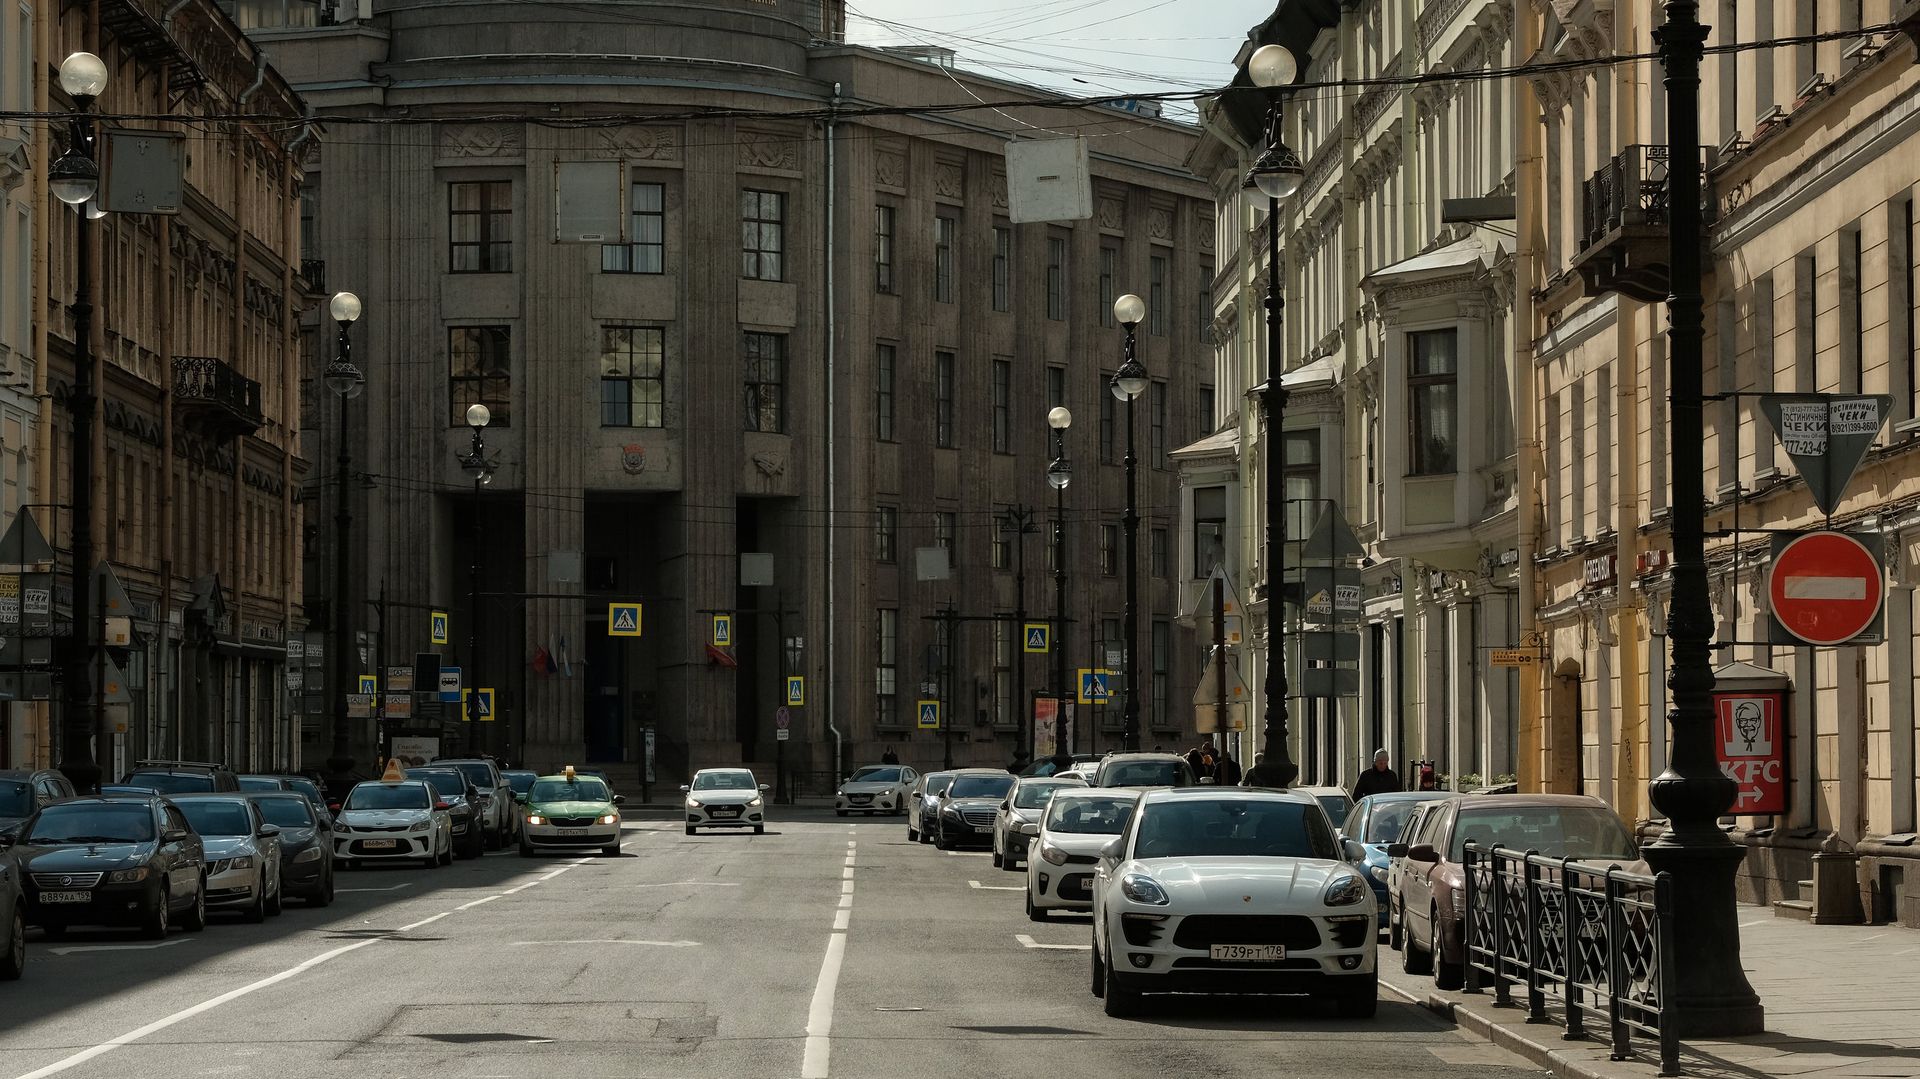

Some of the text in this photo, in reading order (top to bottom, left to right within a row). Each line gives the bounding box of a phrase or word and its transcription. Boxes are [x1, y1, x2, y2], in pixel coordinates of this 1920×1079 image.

[1830, 402, 1876, 414] ГОСТИНИЧНЫЕ
[1783, 412, 1827, 422] ГОСТИНИЧНЫЕ
[1839, 411, 1867, 421] ЧЕКИ
[1783, 422, 1827, 431] ЧЕКИ
[1831, 421, 1878, 433] 8(921)399-8600
[1784, 439, 1827, 454] 777-23-43
[26, 593, 47, 602] ЧЕКИ
[1337, 590, 1358, 598] ЧЕКИ
[1719, 760, 1780, 784] KFC
